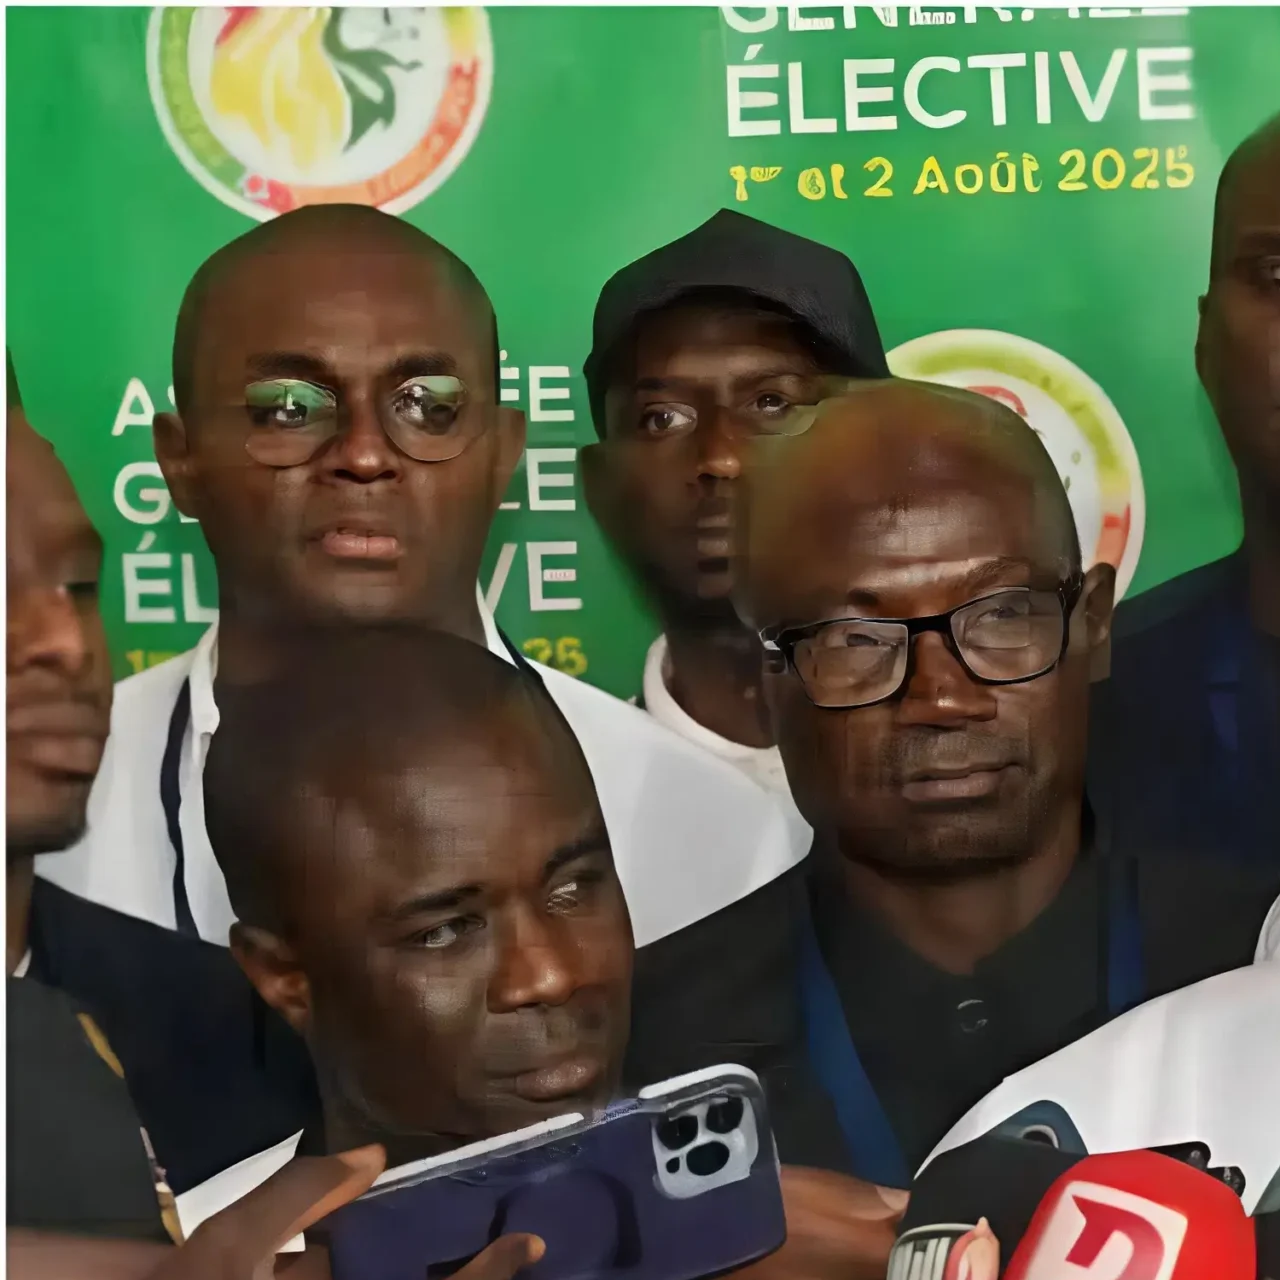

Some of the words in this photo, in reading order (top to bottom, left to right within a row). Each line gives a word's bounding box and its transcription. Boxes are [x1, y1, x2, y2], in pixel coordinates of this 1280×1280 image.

[726, 43, 1195, 137] ÉLECTIVE
[863, 157, 893, 197] 2
[1057, 146, 1195, 191] 2025
